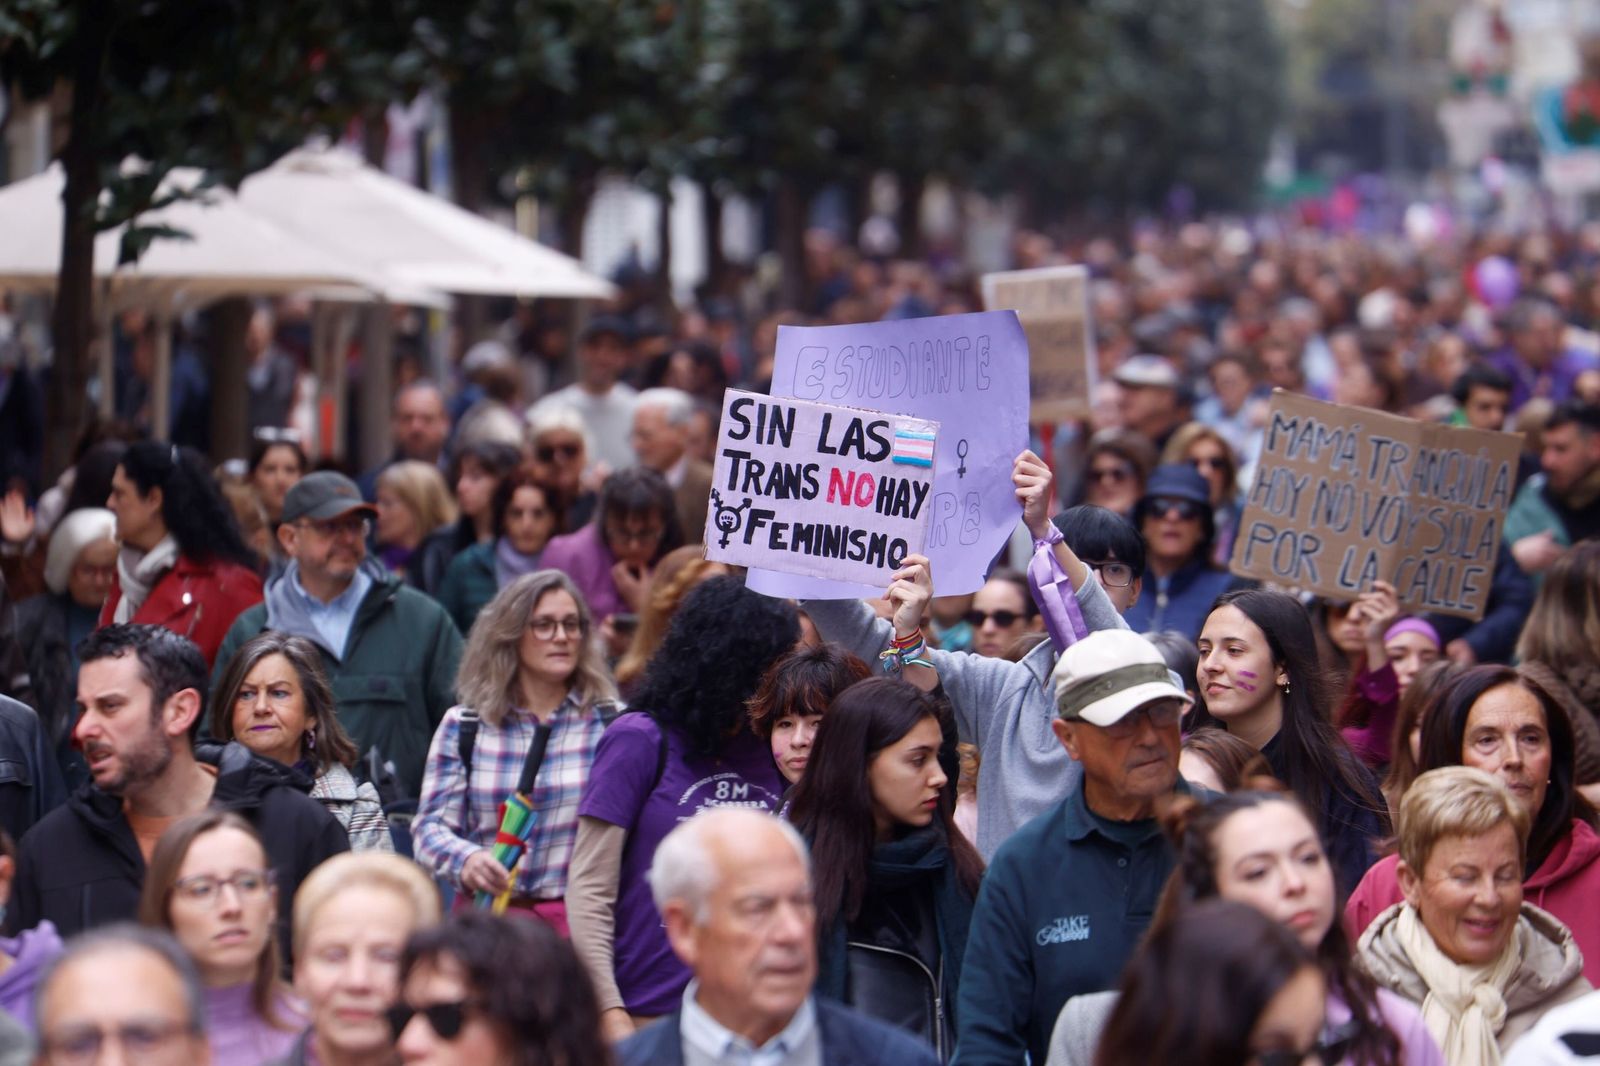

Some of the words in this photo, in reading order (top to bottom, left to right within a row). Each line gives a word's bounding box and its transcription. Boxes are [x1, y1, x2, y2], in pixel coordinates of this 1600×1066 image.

[793, 335, 991, 400] ESTUDIANTE
[728, 397, 796, 448] SIN
[817, 412, 892, 462] LAS
[723, 449, 820, 500] TRANS
[826, 467, 876, 508] NO
[875, 475, 930, 520] HAY
[1251, 467, 1309, 520] HOY
[1310, 478, 1356, 533] NO
[1360, 491, 1425, 549] VOY
[1423, 506, 1497, 561] SOLA
[743, 508, 909, 571] FEMINISMO
[1243, 522, 1322, 584] POR
[1339, 544, 1381, 593] LA
[1393, 557, 1485, 610] CALLE
[715, 780, 750, 800] 8M
[1053, 914, 1089, 932] TAKE
